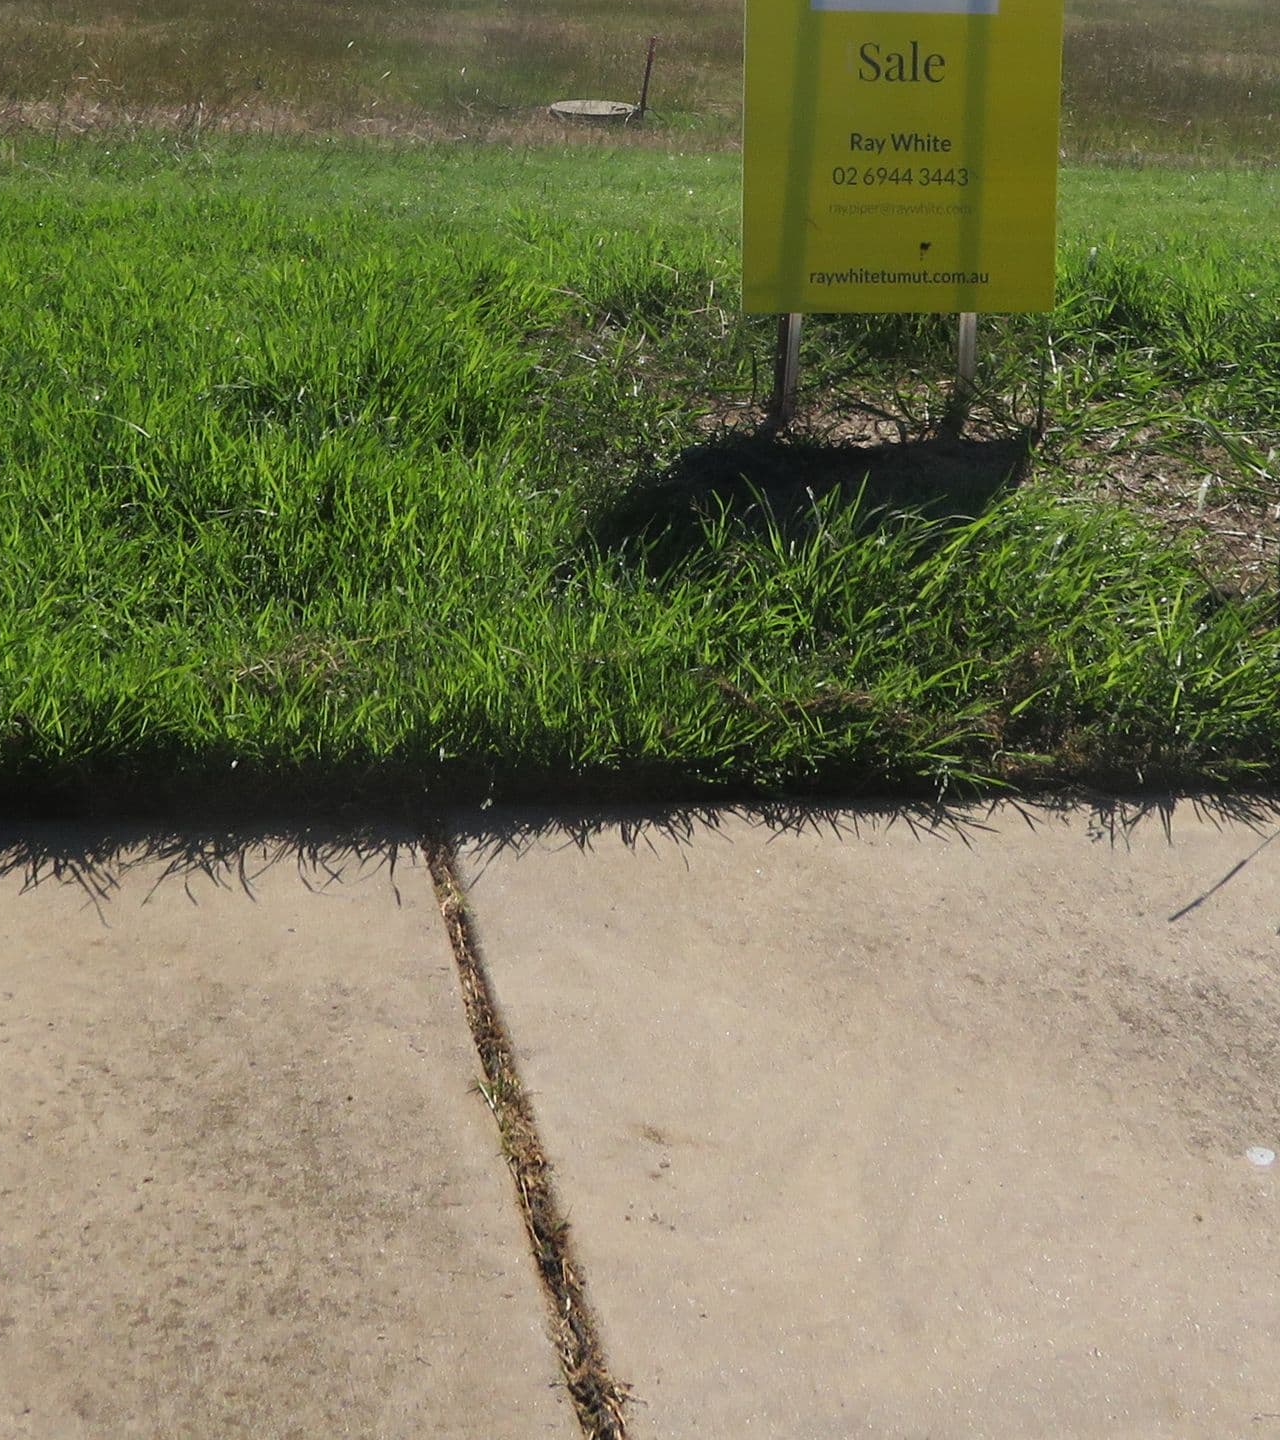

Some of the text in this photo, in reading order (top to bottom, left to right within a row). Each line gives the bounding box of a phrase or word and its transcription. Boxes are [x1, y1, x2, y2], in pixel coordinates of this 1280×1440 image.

[859, 41, 945, 82] Sale
[850, 133, 952, 154] Ray White
[832, 167, 969, 186] 02 6944 3443
[810, 268, 989, 286] raywhitetumut.com.au
